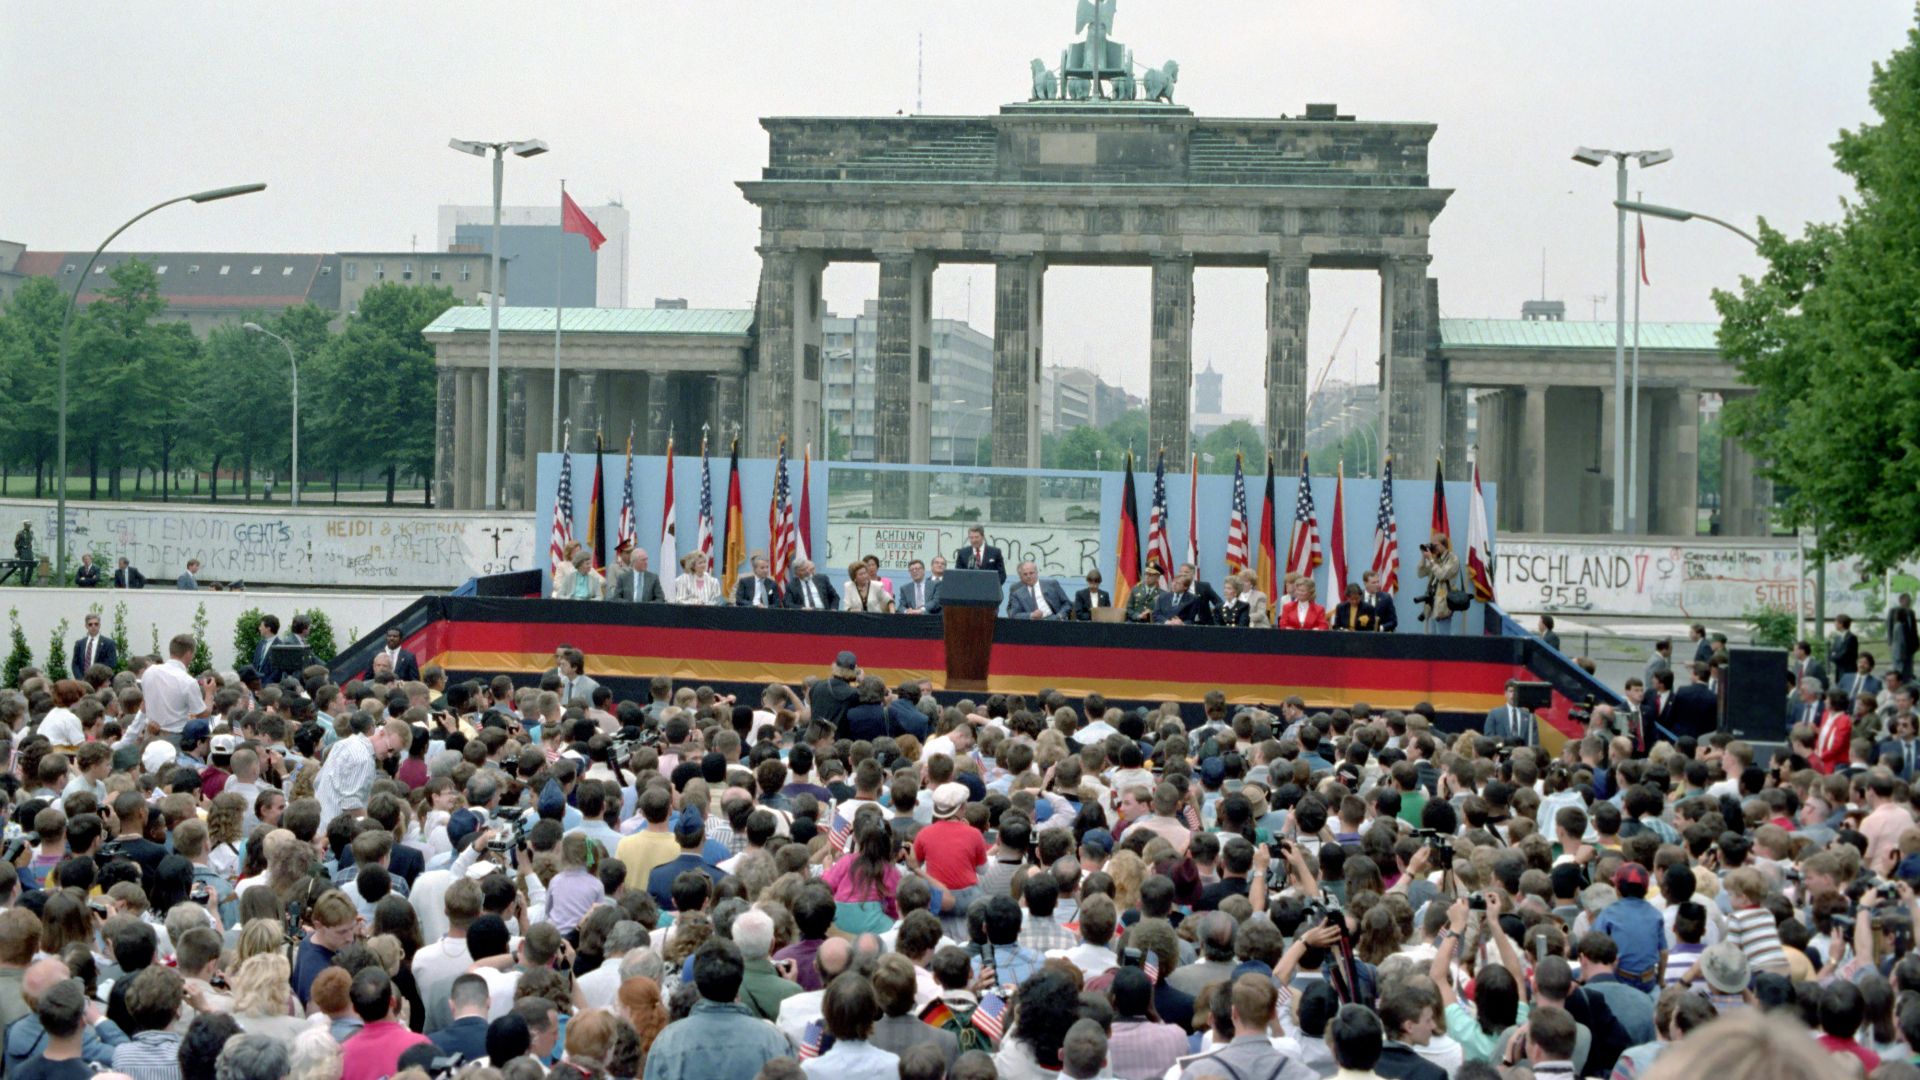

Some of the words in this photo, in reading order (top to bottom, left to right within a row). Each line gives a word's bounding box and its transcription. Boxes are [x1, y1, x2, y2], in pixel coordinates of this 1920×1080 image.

[327, 520, 373, 537] HEIDI
[400, 520, 466, 534] KATRIN
[875, 530, 925, 541] ACHTUNG!
[883, 550, 914, 561] JETZT
